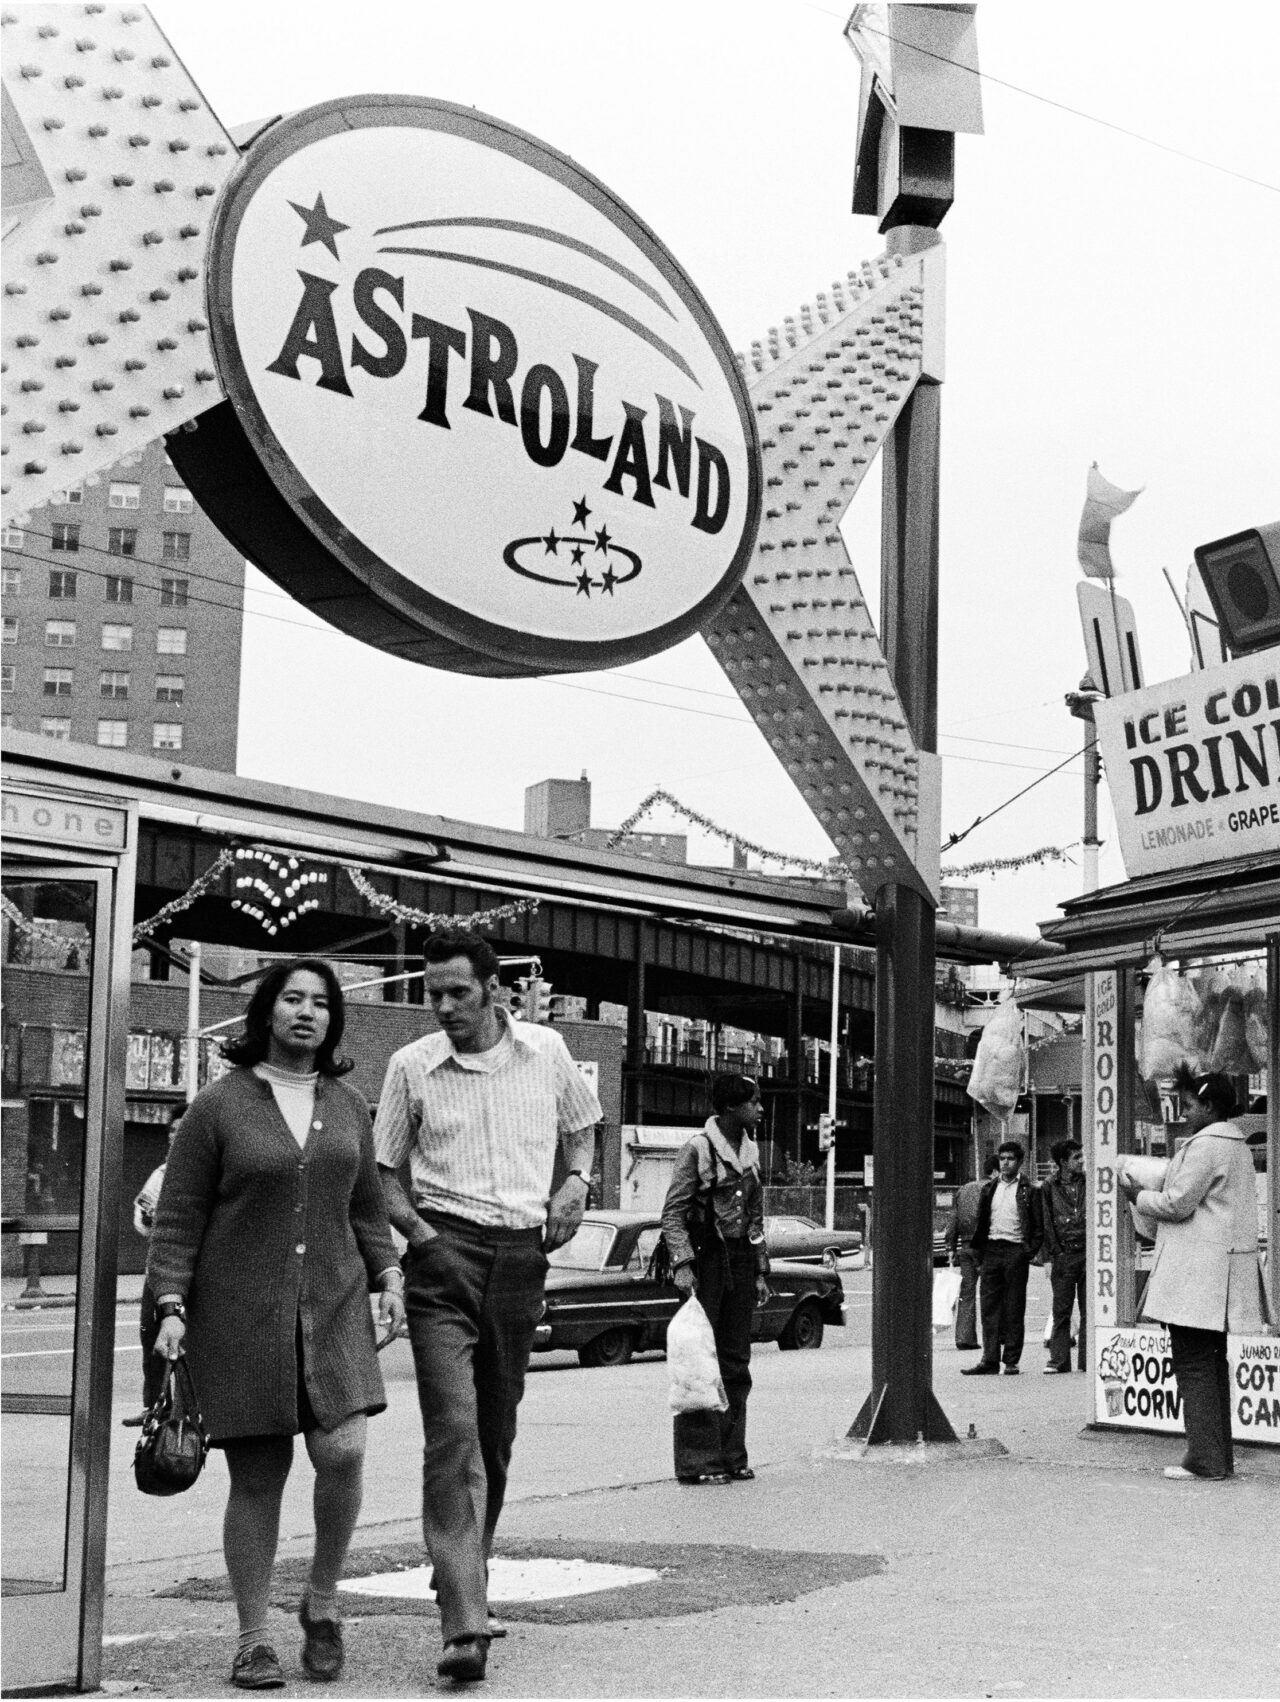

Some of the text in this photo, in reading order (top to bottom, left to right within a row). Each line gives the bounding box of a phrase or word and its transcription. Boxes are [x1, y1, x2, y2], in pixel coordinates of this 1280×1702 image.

[265, 267, 731, 535] ASTROLAND
[1124, 700, 1189, 750] ICE
[1140, 818, 1215, 850] LEMONADE
[1227, 804, 1280, 832] GRAPE
[1097, 976, 1112, 998] ICE
[1096, 1020, 1115, 1297] ROOT BEER
[1132, 1353, 1174, 1385] POP
[1240, 1344, 1271, 1360] JUMBO
[1124, 1386, 1181, 1420] CORN
